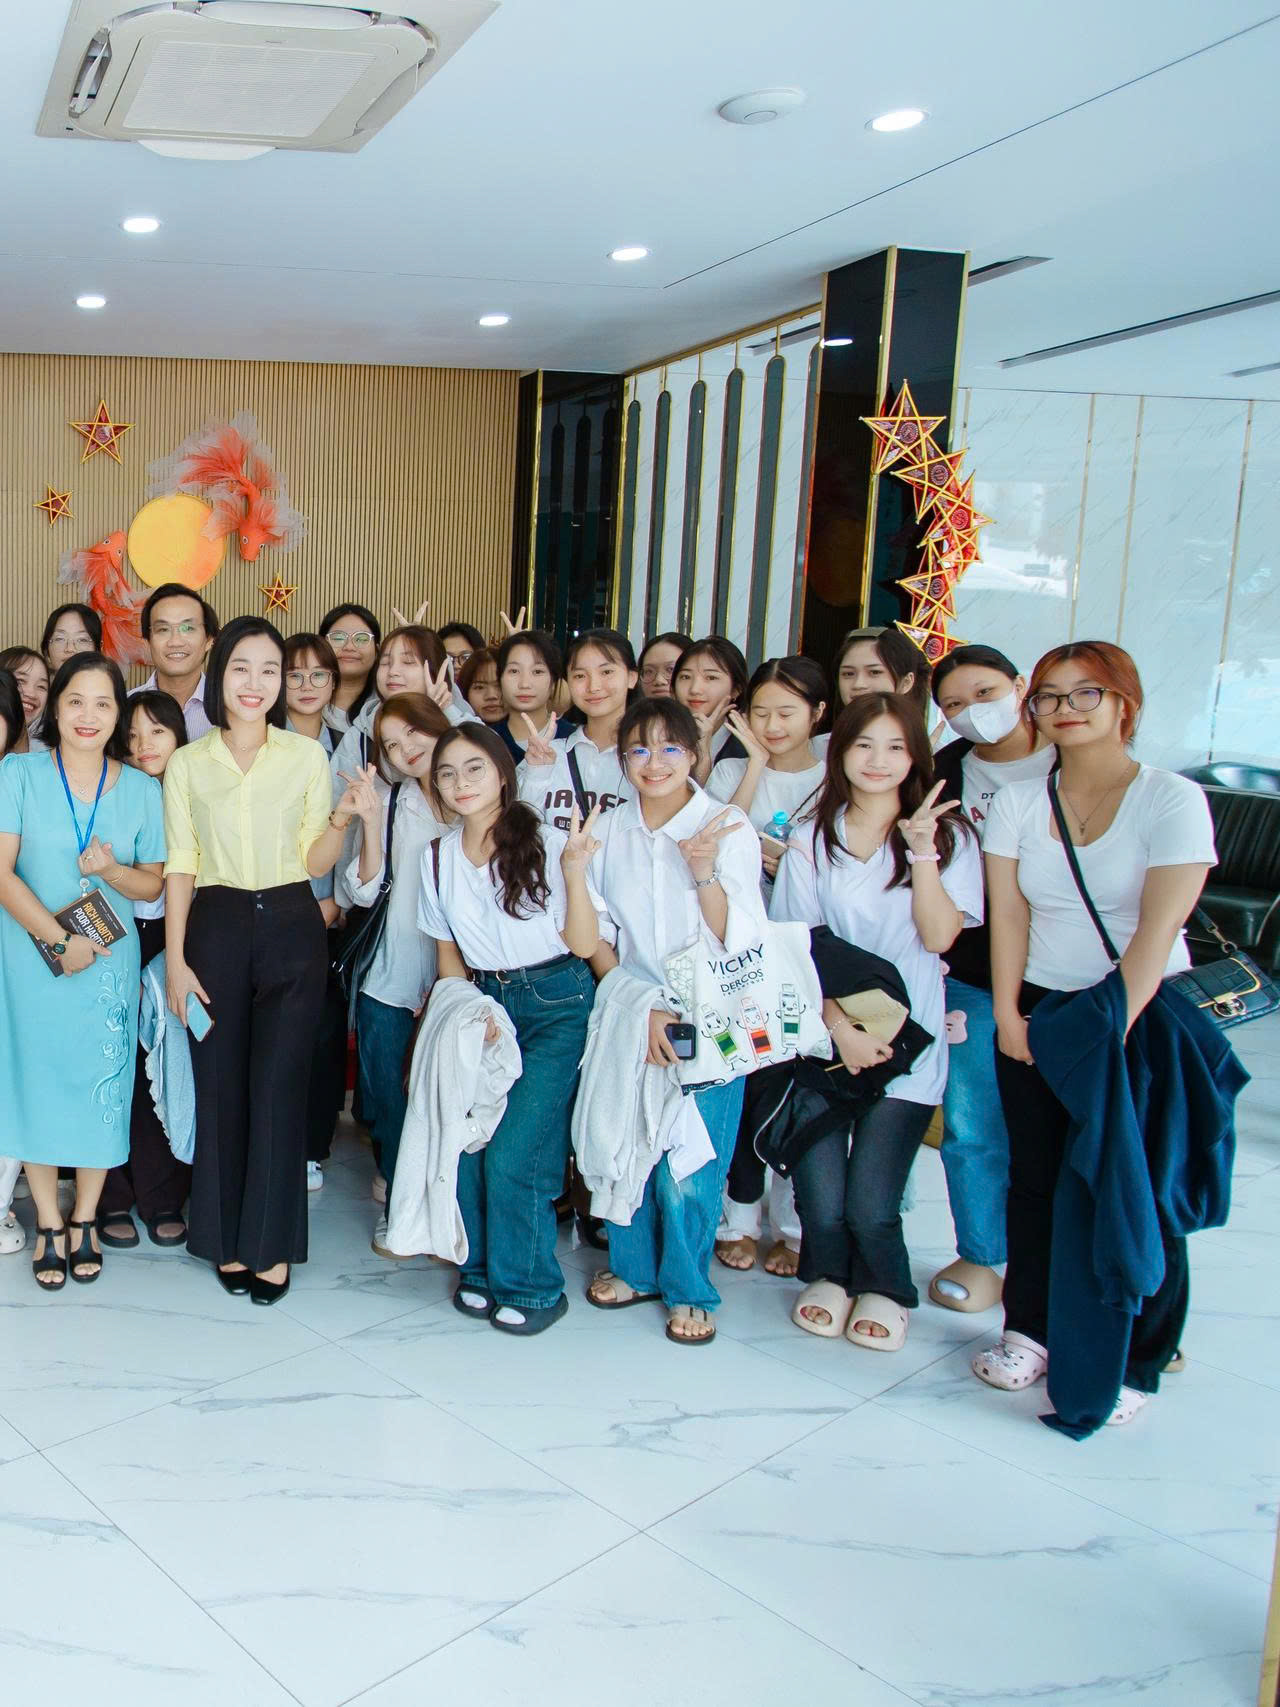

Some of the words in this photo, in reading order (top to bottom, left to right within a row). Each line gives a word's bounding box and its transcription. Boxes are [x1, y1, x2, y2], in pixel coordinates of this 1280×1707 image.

[73, 908, 90, 927] POOR
[83, 902, 99, 921] RICH
[93, 916, 114, 943] HABITS
[707, 943, 764, 975] VICHY
[720, 969, 764, 993] DERCOS
